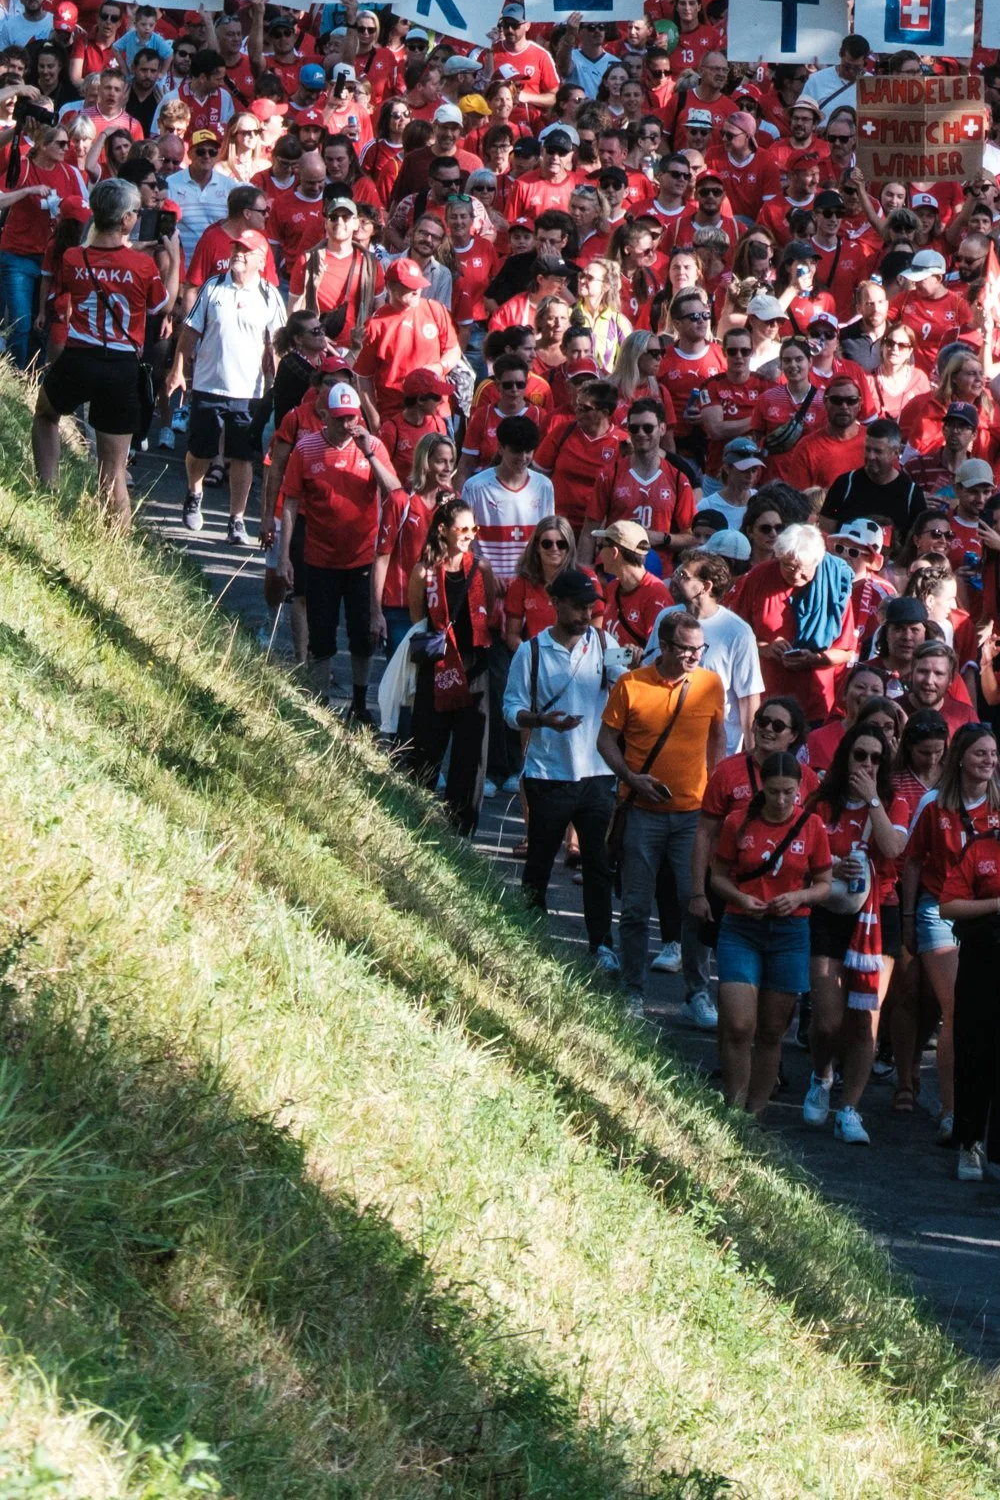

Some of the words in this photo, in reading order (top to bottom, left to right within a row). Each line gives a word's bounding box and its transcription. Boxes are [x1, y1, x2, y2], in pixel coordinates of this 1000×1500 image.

[681, 49, 694, 64] 13
[860, 76, 981, 106] WANDELER
[880, 119, 960, 146] MATCH
[216, 258, 231, 271] SW
[629, 297, 639, 316] 9
[77, 290, 131, 343] 10
[921, 322, 931, 341] 9
